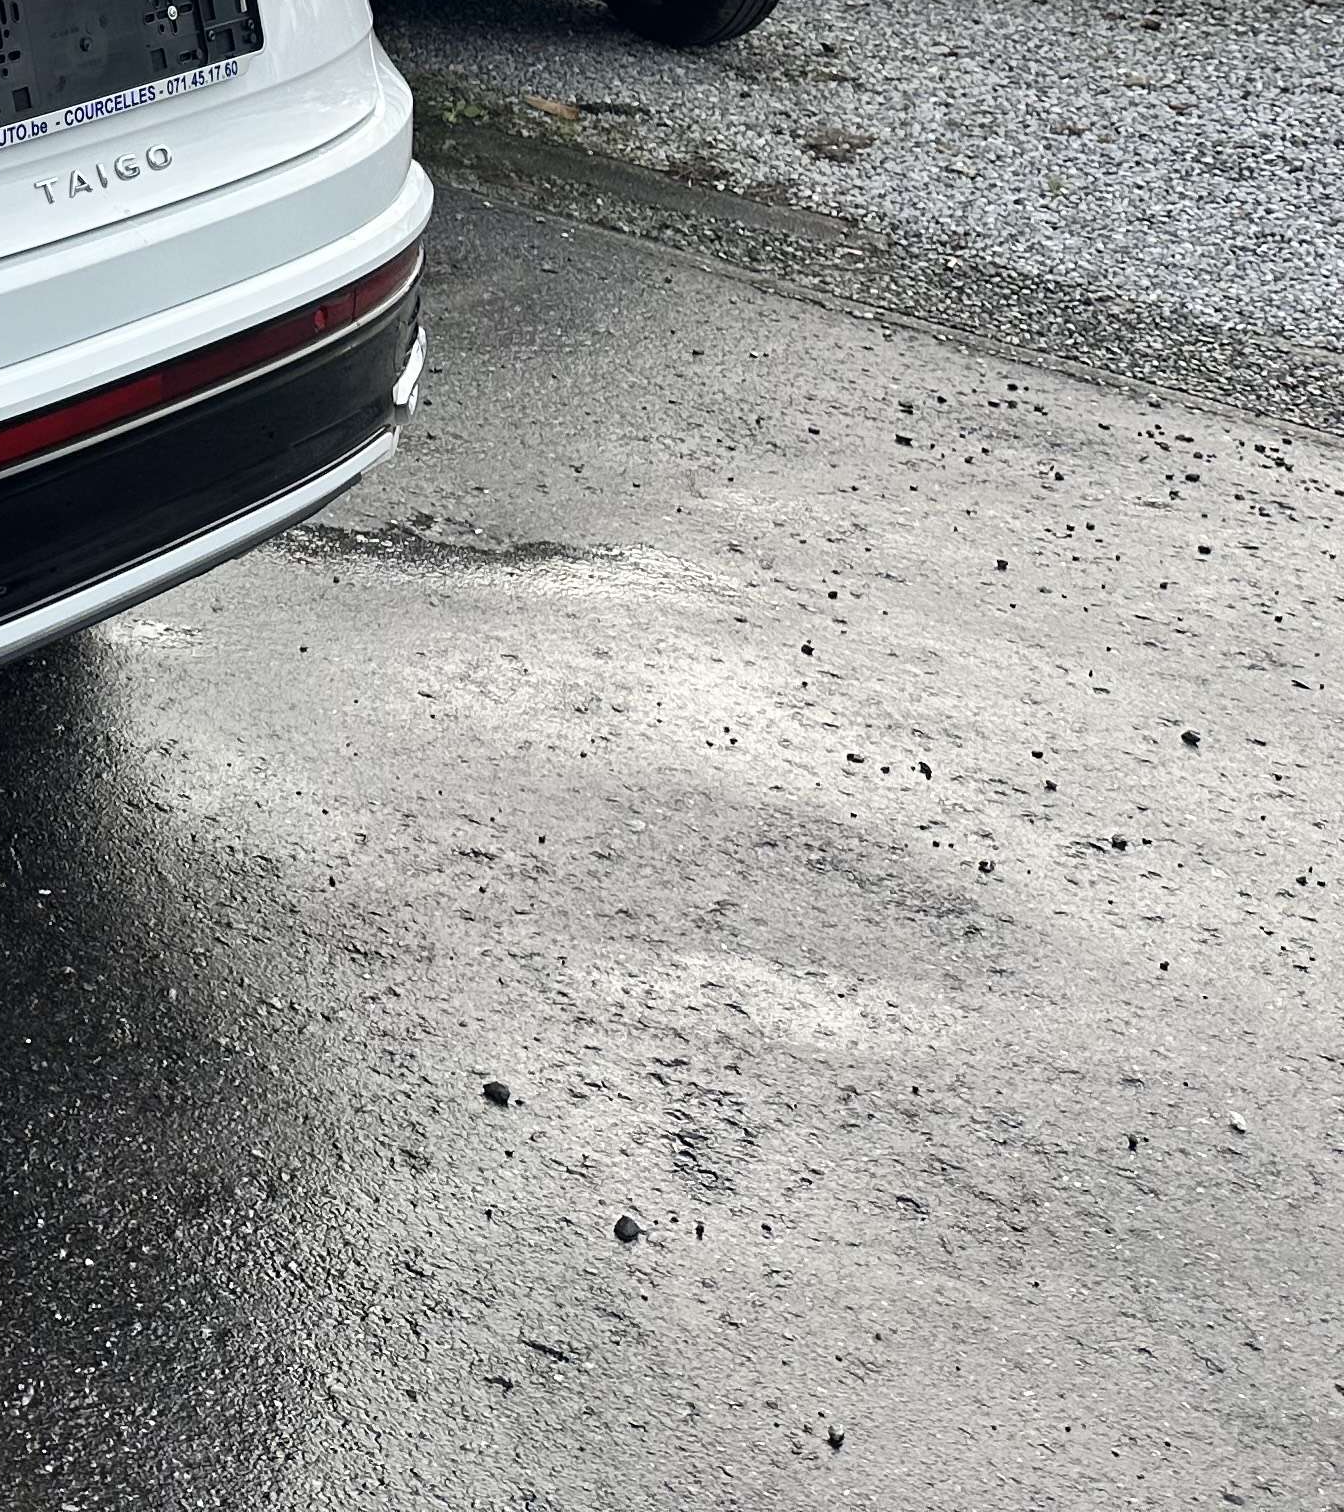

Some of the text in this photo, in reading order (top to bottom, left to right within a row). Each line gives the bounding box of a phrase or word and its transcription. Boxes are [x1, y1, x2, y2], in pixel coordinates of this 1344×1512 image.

[64, 85, 156, 126] COURCELLES
[167, 60, 239, 96] 071.45.17.60
[34, 143, 173, 204] TAIGO
